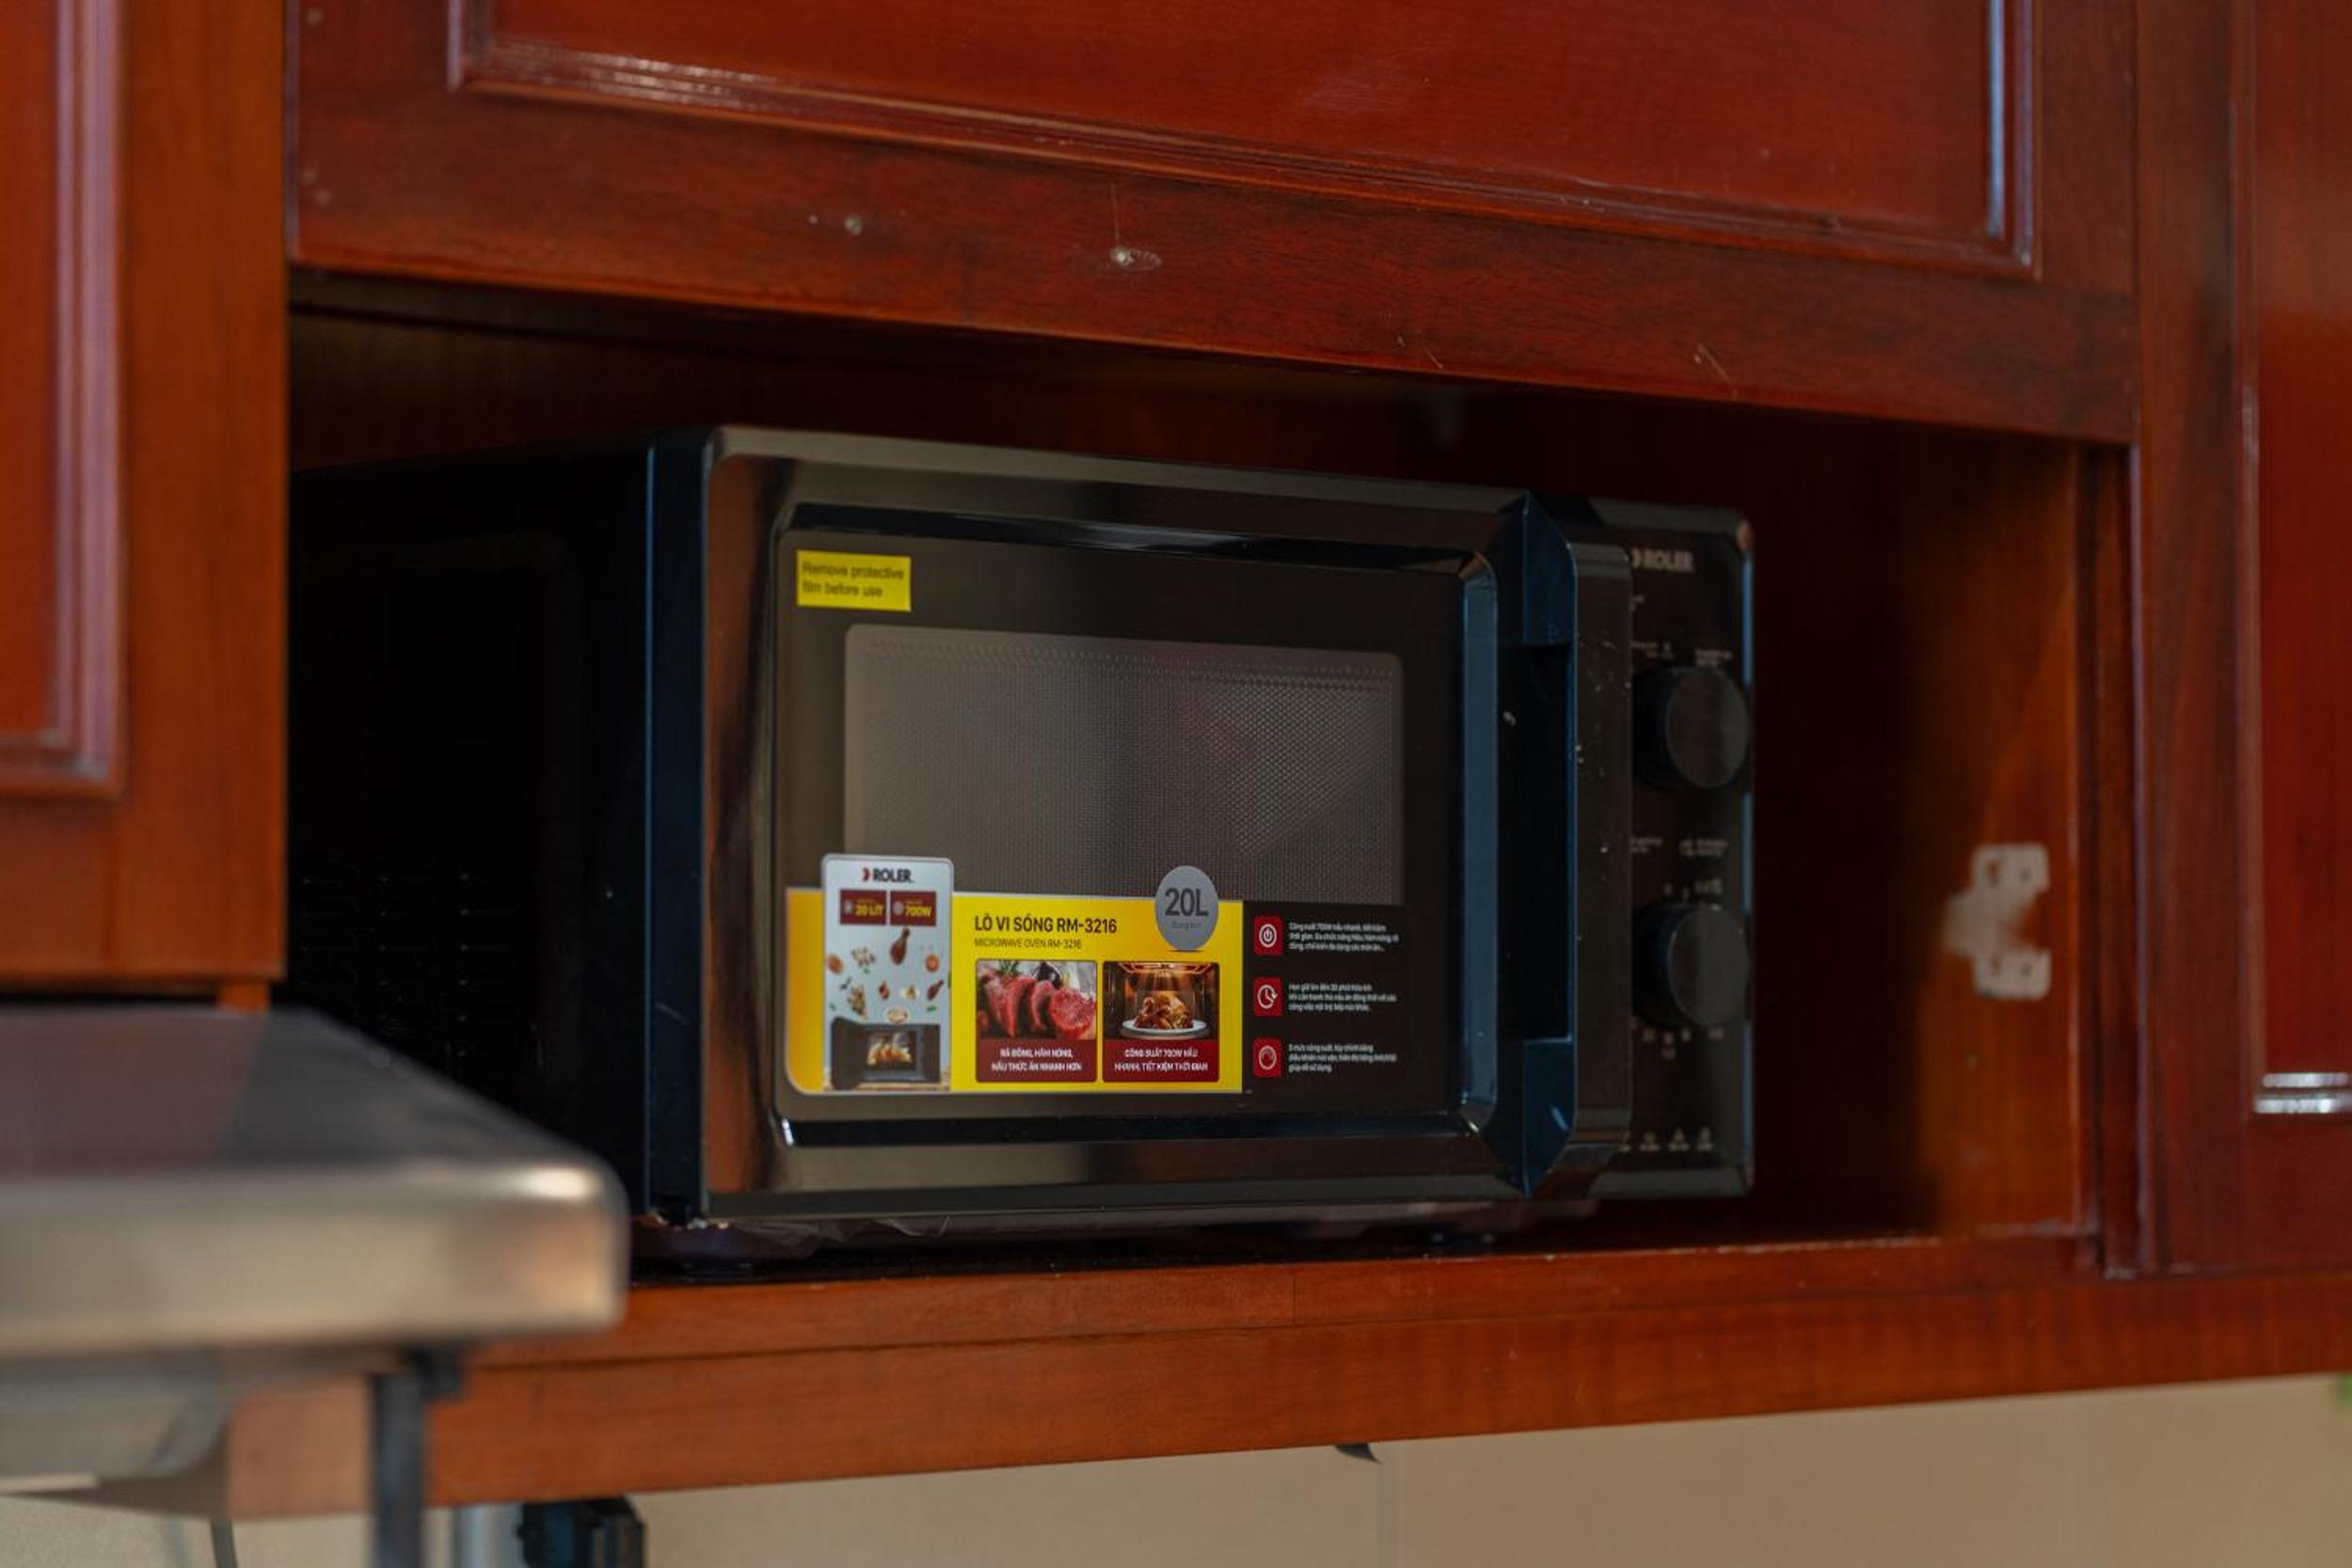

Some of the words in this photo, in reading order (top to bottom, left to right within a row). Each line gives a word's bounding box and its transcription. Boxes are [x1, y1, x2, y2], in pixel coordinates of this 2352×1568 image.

[803, 562, 848, 576] Remove
[851, 566, 904, 580] protective
[803, 580, 822, 594] film
[825, 581, 859, 596] before
[863, 587, 882, 598] use
[873, 867, 913, 883] ROLER
[1165, 887, 1208, 916] 20L
[975, 912, 993, 932] LÒ
[995, 916, 1009, 932] VI
[1013, 912, 1054, 933] SÓNG
[1057, 917, 1118, 934] RM-3216
[1024, 939, 1046, 948] OVEN
